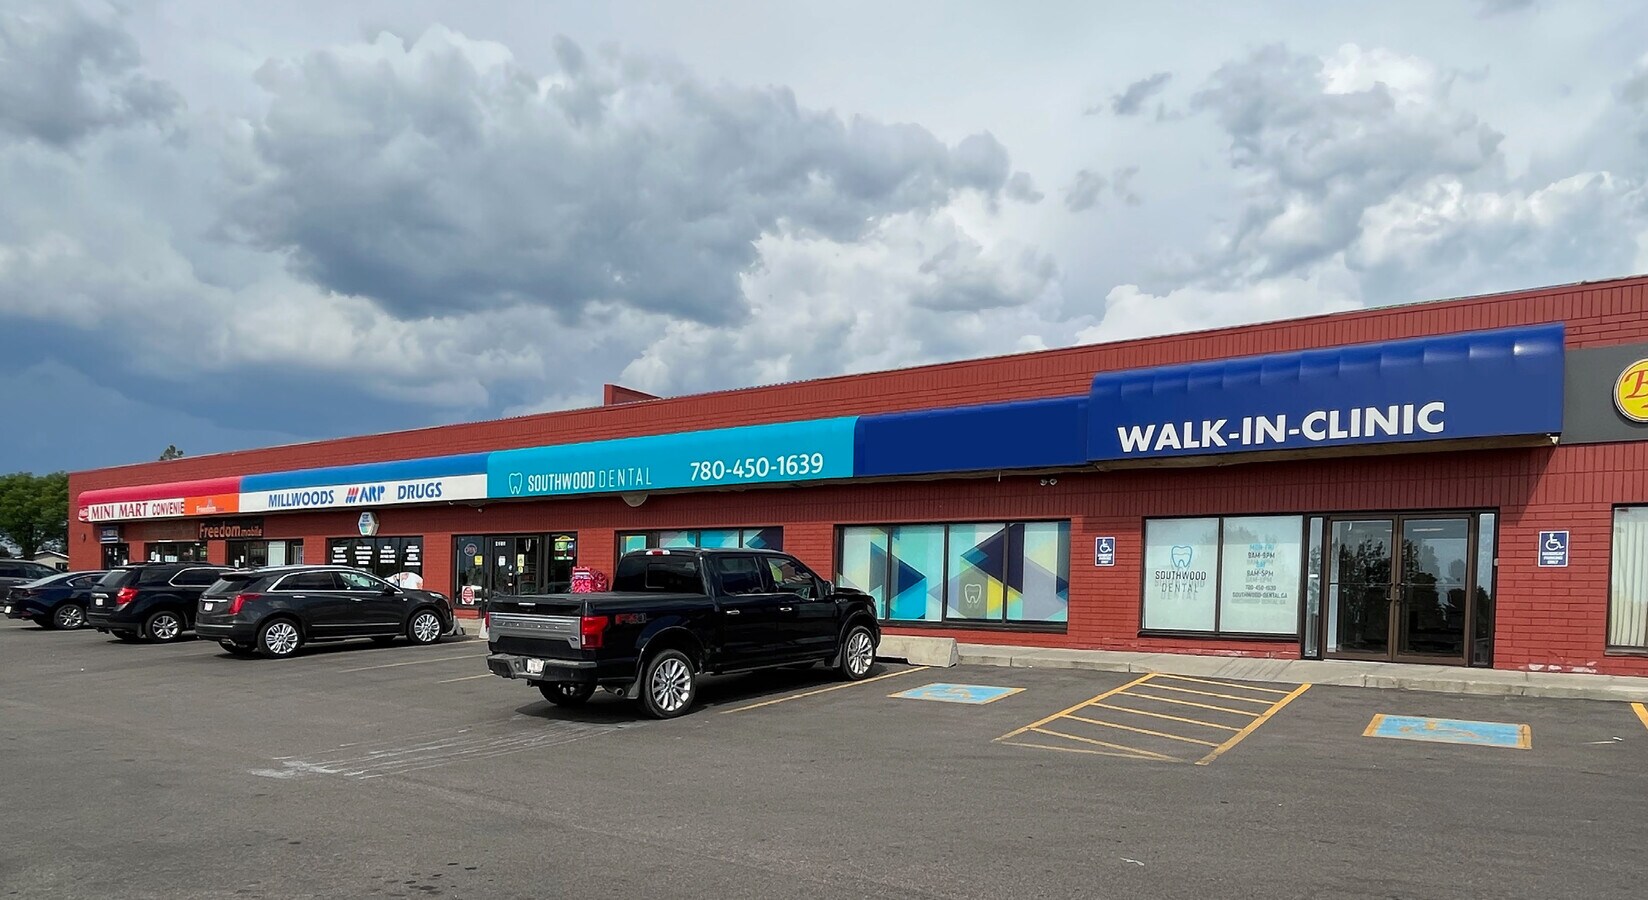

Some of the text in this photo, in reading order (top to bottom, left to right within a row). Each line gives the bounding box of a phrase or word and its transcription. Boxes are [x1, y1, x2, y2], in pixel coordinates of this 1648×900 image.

[1117, 401, 1445, 453] WALK-IN-CLINIC
[690, 452, 824, 482] 780-450-1639
[527, 466, 653, 492] SOUTHWOOD DENTAL
[268, 490, 335, 508] MILLWOODS
[397, 482, 443, 500] DRUGS
[91, 504, 115, 520] MINI
[119, 502, 149, 518] MART
[199, 521, 263, 539] Freedom mobile
[1155, 570, 1207, 581] SOUTHWOOD
[1161, 582, 1199, 593] DENTAL
